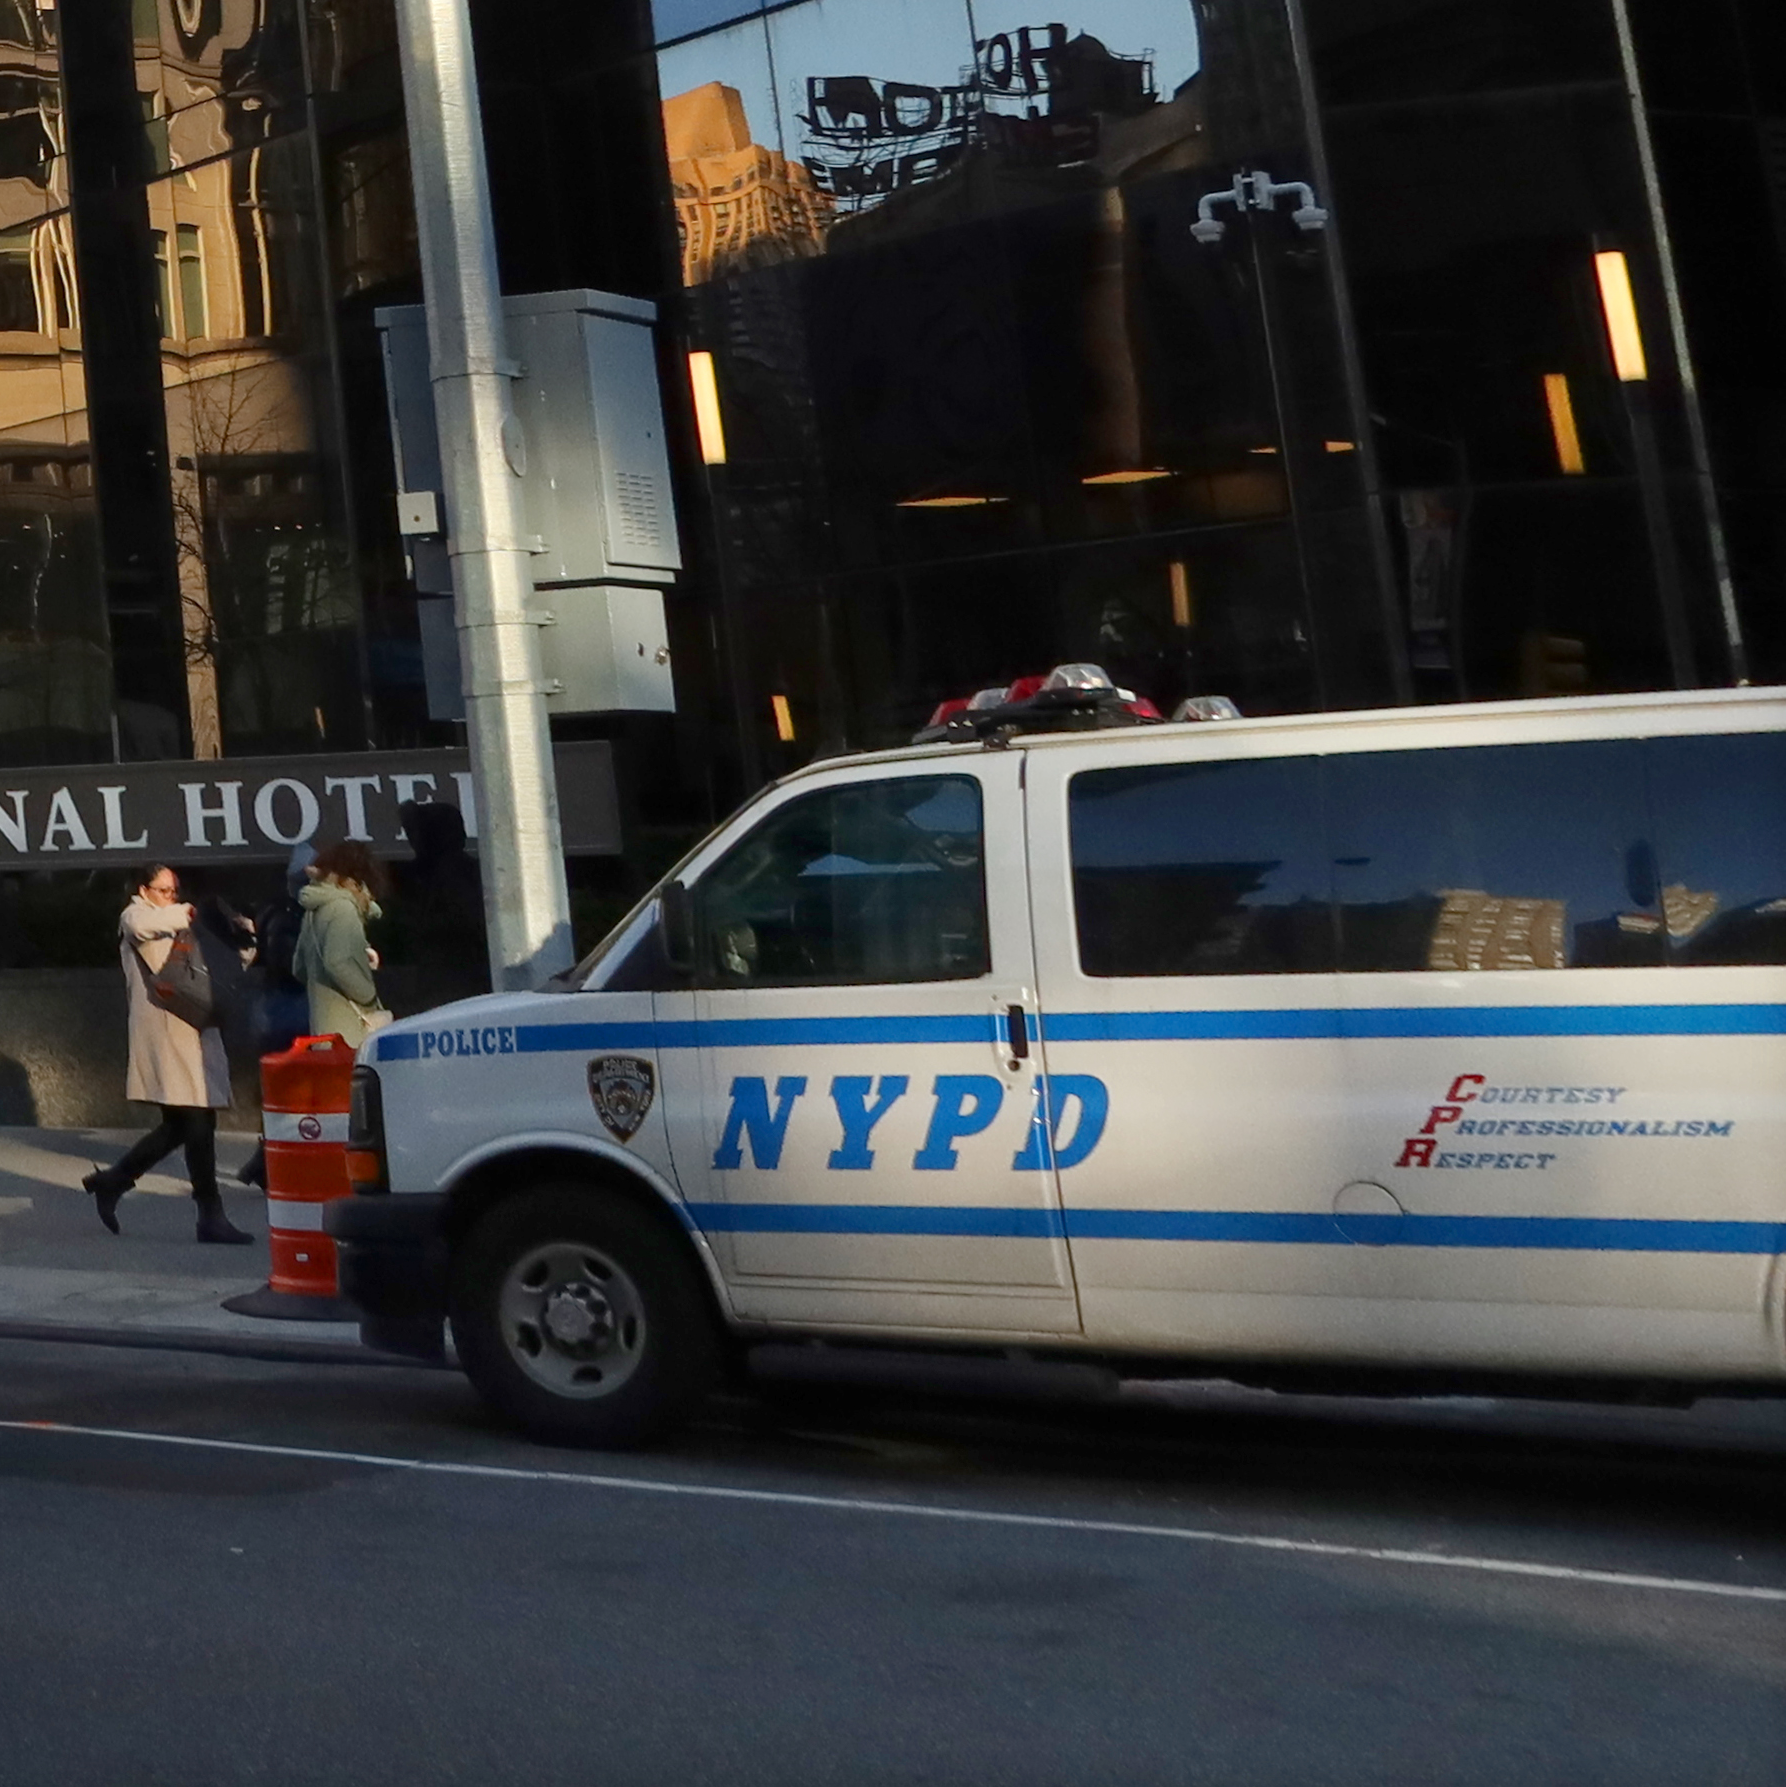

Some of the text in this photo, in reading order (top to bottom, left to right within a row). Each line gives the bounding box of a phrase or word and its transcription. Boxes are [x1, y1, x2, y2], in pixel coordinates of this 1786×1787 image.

[421, 1026, 515, 1058] POLICE
[1445, 1074, 1626, 1104] COURTESY
[711, 1074, 1109, 1171] NYPD
[1418, 1106, 1735, 1137] PROFESSIONALISM
[1394, 1139, 1557, 1169] RESPECT
